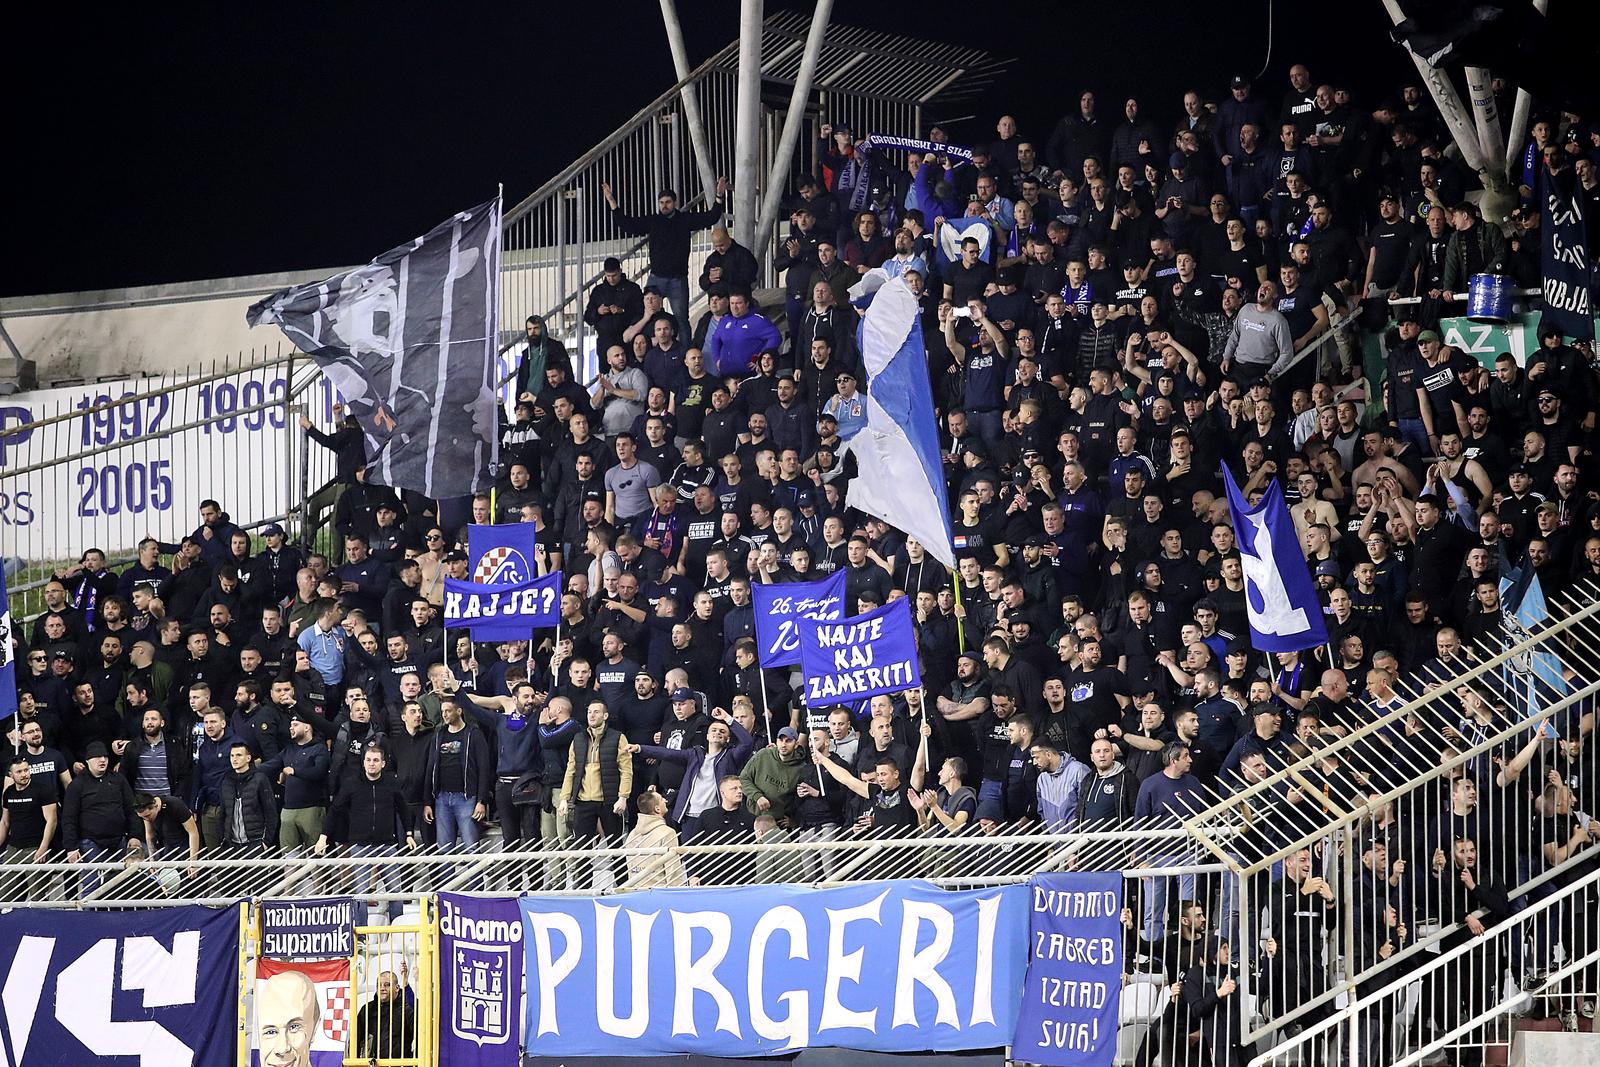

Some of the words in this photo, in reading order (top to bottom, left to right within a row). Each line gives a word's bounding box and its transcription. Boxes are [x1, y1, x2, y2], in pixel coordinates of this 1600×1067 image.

[1292, 104, 1311, 114] PUMA
[870, 135, 931, 149] GRADJANSKI
[933, 143, 946, 151] JE
[77, 391, 170, 446] 1992
[199, 379, 287, 434] 1993
[77, 460, 172, 517] 2005
[444, 592, 500, 618] KAJ
[503, 587, 555, 615] JE?
[769, 597, 792, 615] 26.
[817, 617, 884, 648] NAJTE
[834, 643, 874, 671] KAJ
[808, 660, 913, 699] ZAMERITI
[1034, 886, 1116, 918] DINAMO
[440, 900, 522, 943] dinamo
[265, 926, 350, 956] suparnik
[1035, 931, 1115, 966] ZAGREB
[527, 887, 1002, 1050] PURGERI
[1041, 977, 1107, 1010] IZNAD
